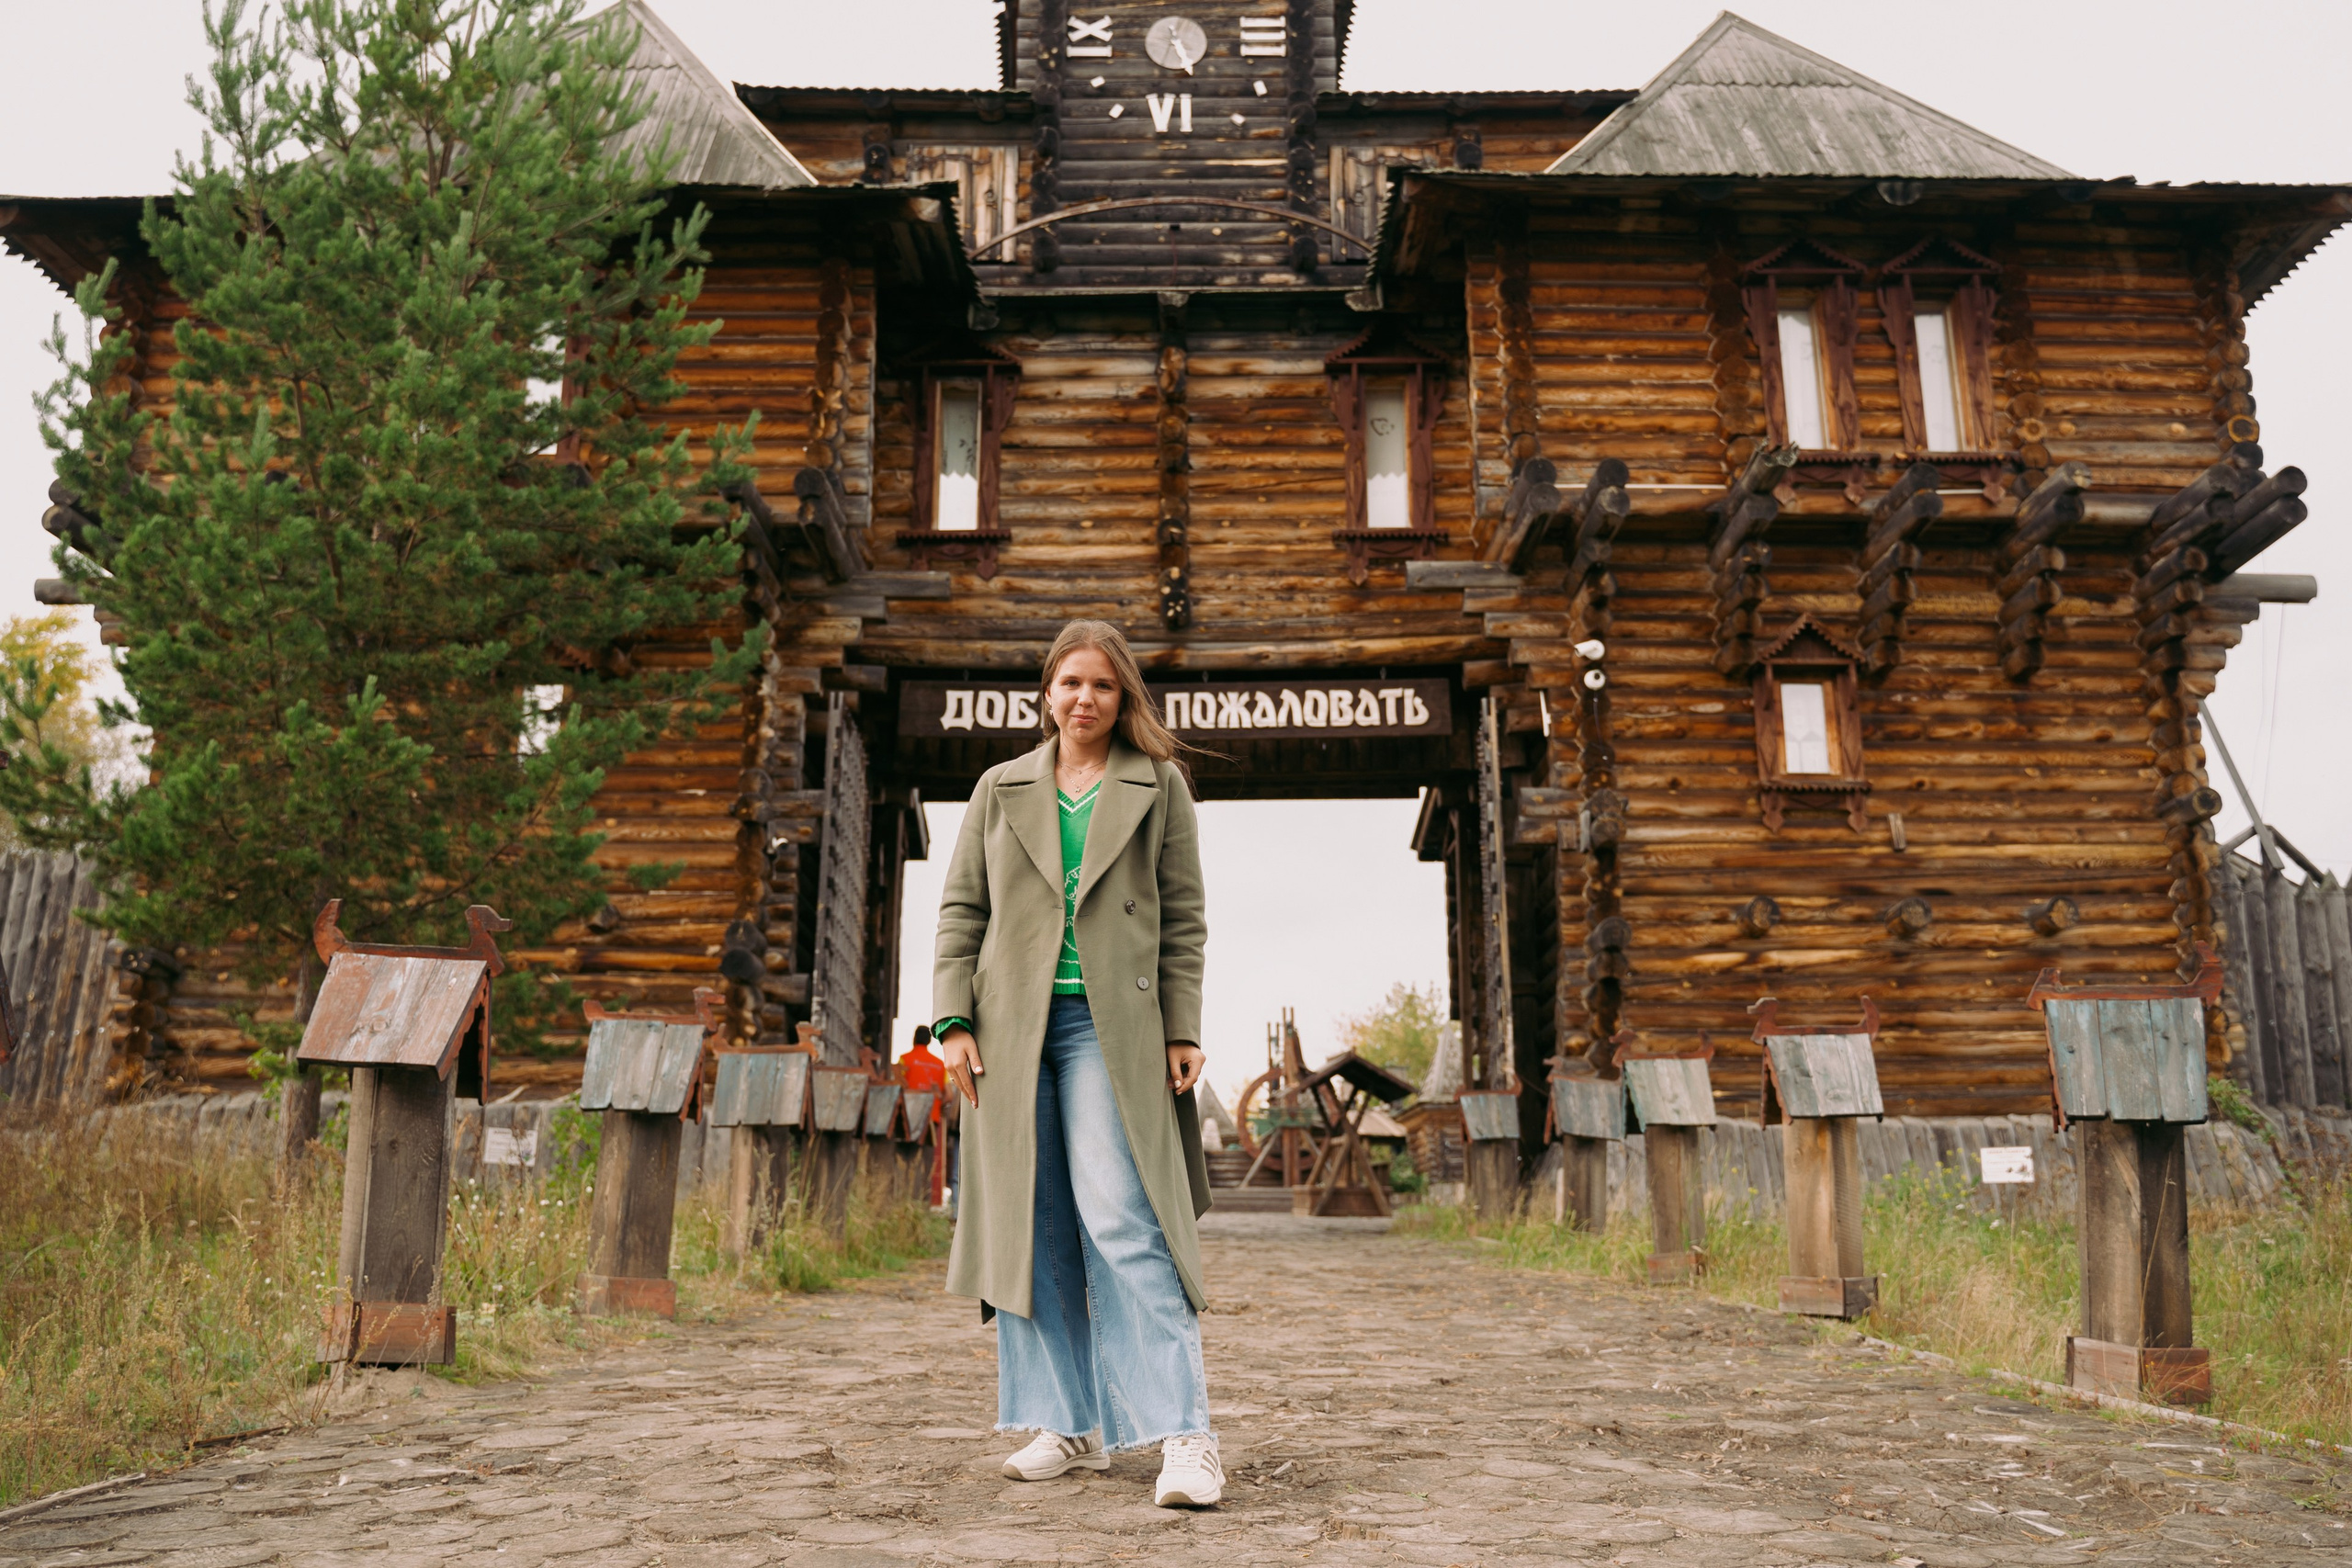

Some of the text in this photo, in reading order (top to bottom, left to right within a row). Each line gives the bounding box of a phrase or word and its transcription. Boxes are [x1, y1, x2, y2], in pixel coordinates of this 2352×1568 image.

[1145, 93, 1193, 133] VI
[940, 687, 1430, 731] ДОБ ПОЖАЛОВАТЬ
